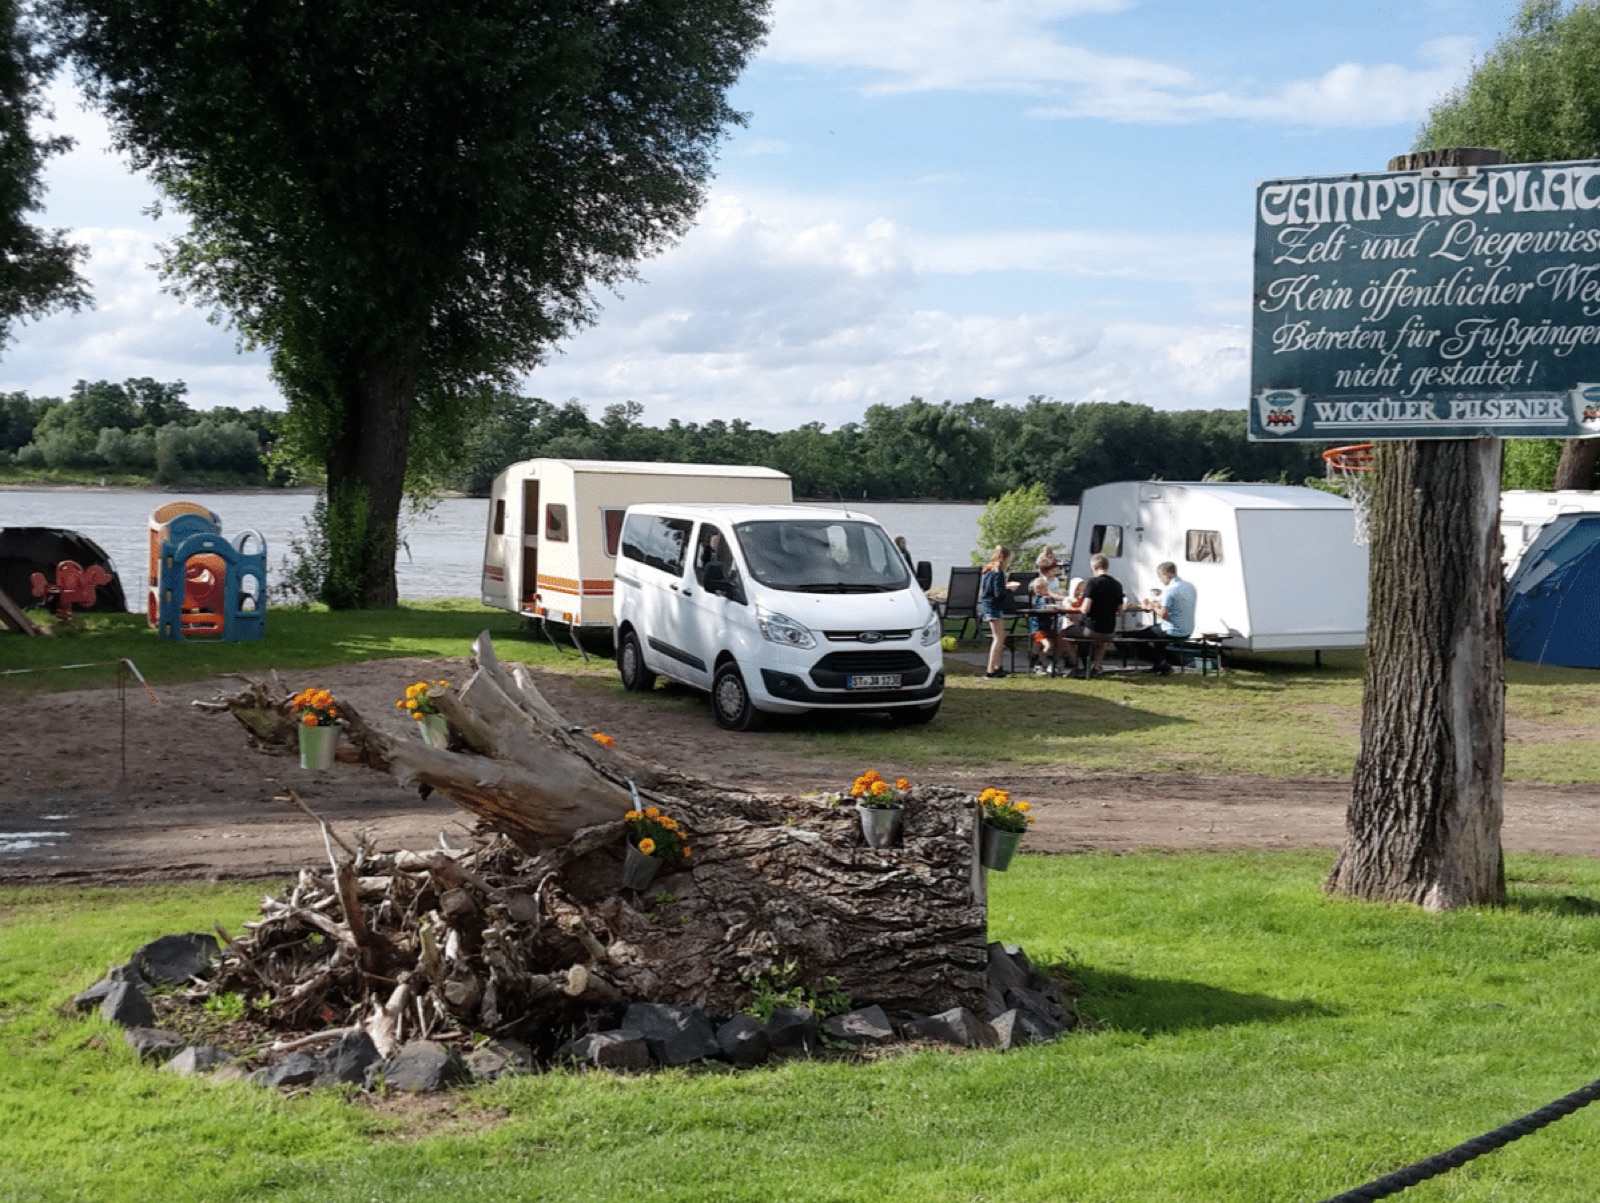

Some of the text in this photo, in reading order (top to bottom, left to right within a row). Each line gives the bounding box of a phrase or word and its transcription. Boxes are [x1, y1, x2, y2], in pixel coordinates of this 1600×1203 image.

[1261, 167, 1600, 225] CAMPINGPLAT
[1429, 219, 1600, 267] Liegewies
[1260, 275, 1352, 312] Kein
[1360, 266, 1534, 322] öffentlicher
[1273, 320, 1388, 355] Betreten
[1381, 315, 1441, 356] für
[1335, 353, 1402, 388] nicht
[1313, 398, 1569, 421] WICKÜLER PILSENER
